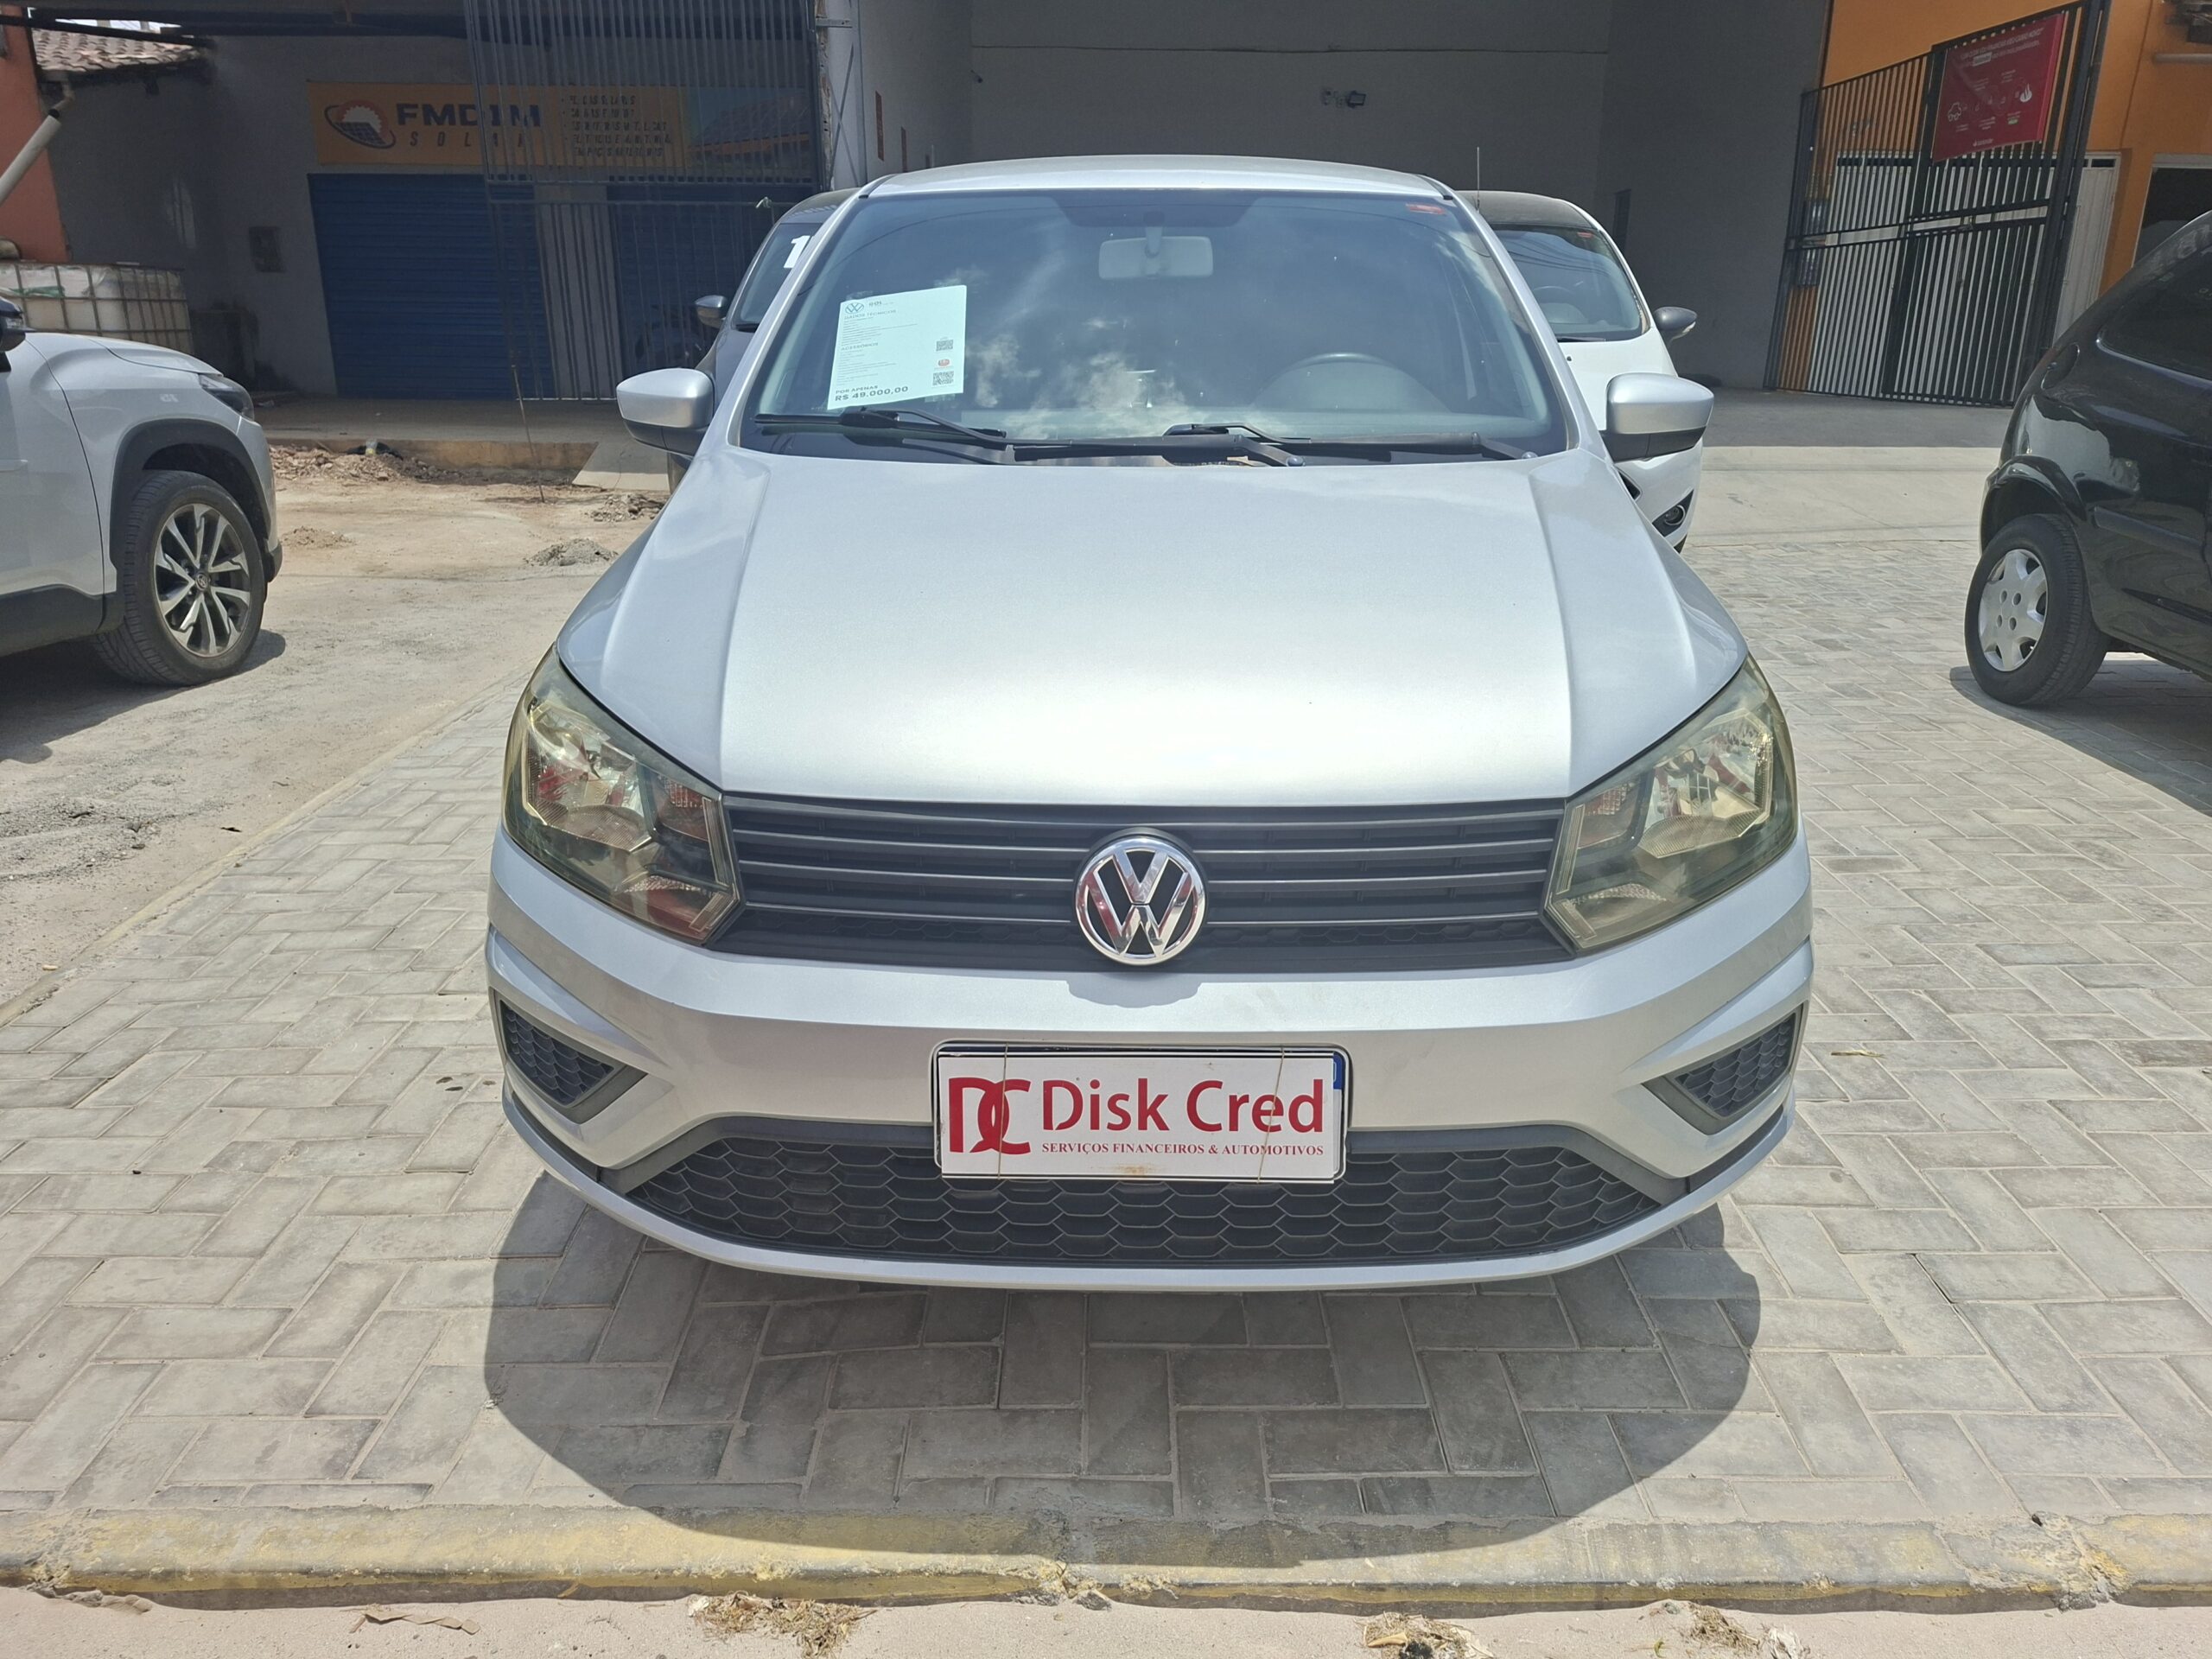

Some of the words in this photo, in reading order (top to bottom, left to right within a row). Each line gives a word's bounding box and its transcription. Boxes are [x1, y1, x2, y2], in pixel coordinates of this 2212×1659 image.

[852, 385, 909, 399] 49.000,00
[1042, 1077, 1170, 1132] Disk
[1186, 1077, 1325, 1134] Cred
[1041, 1142, 1109, 1155] SERVIÇOS
[1113, 1142, 1205, 1154] FINANCEIROS
[1208, 1144, 1218, 1155] &
[1222, 1144, 1325, 1156] AUTOMOTIVOS
